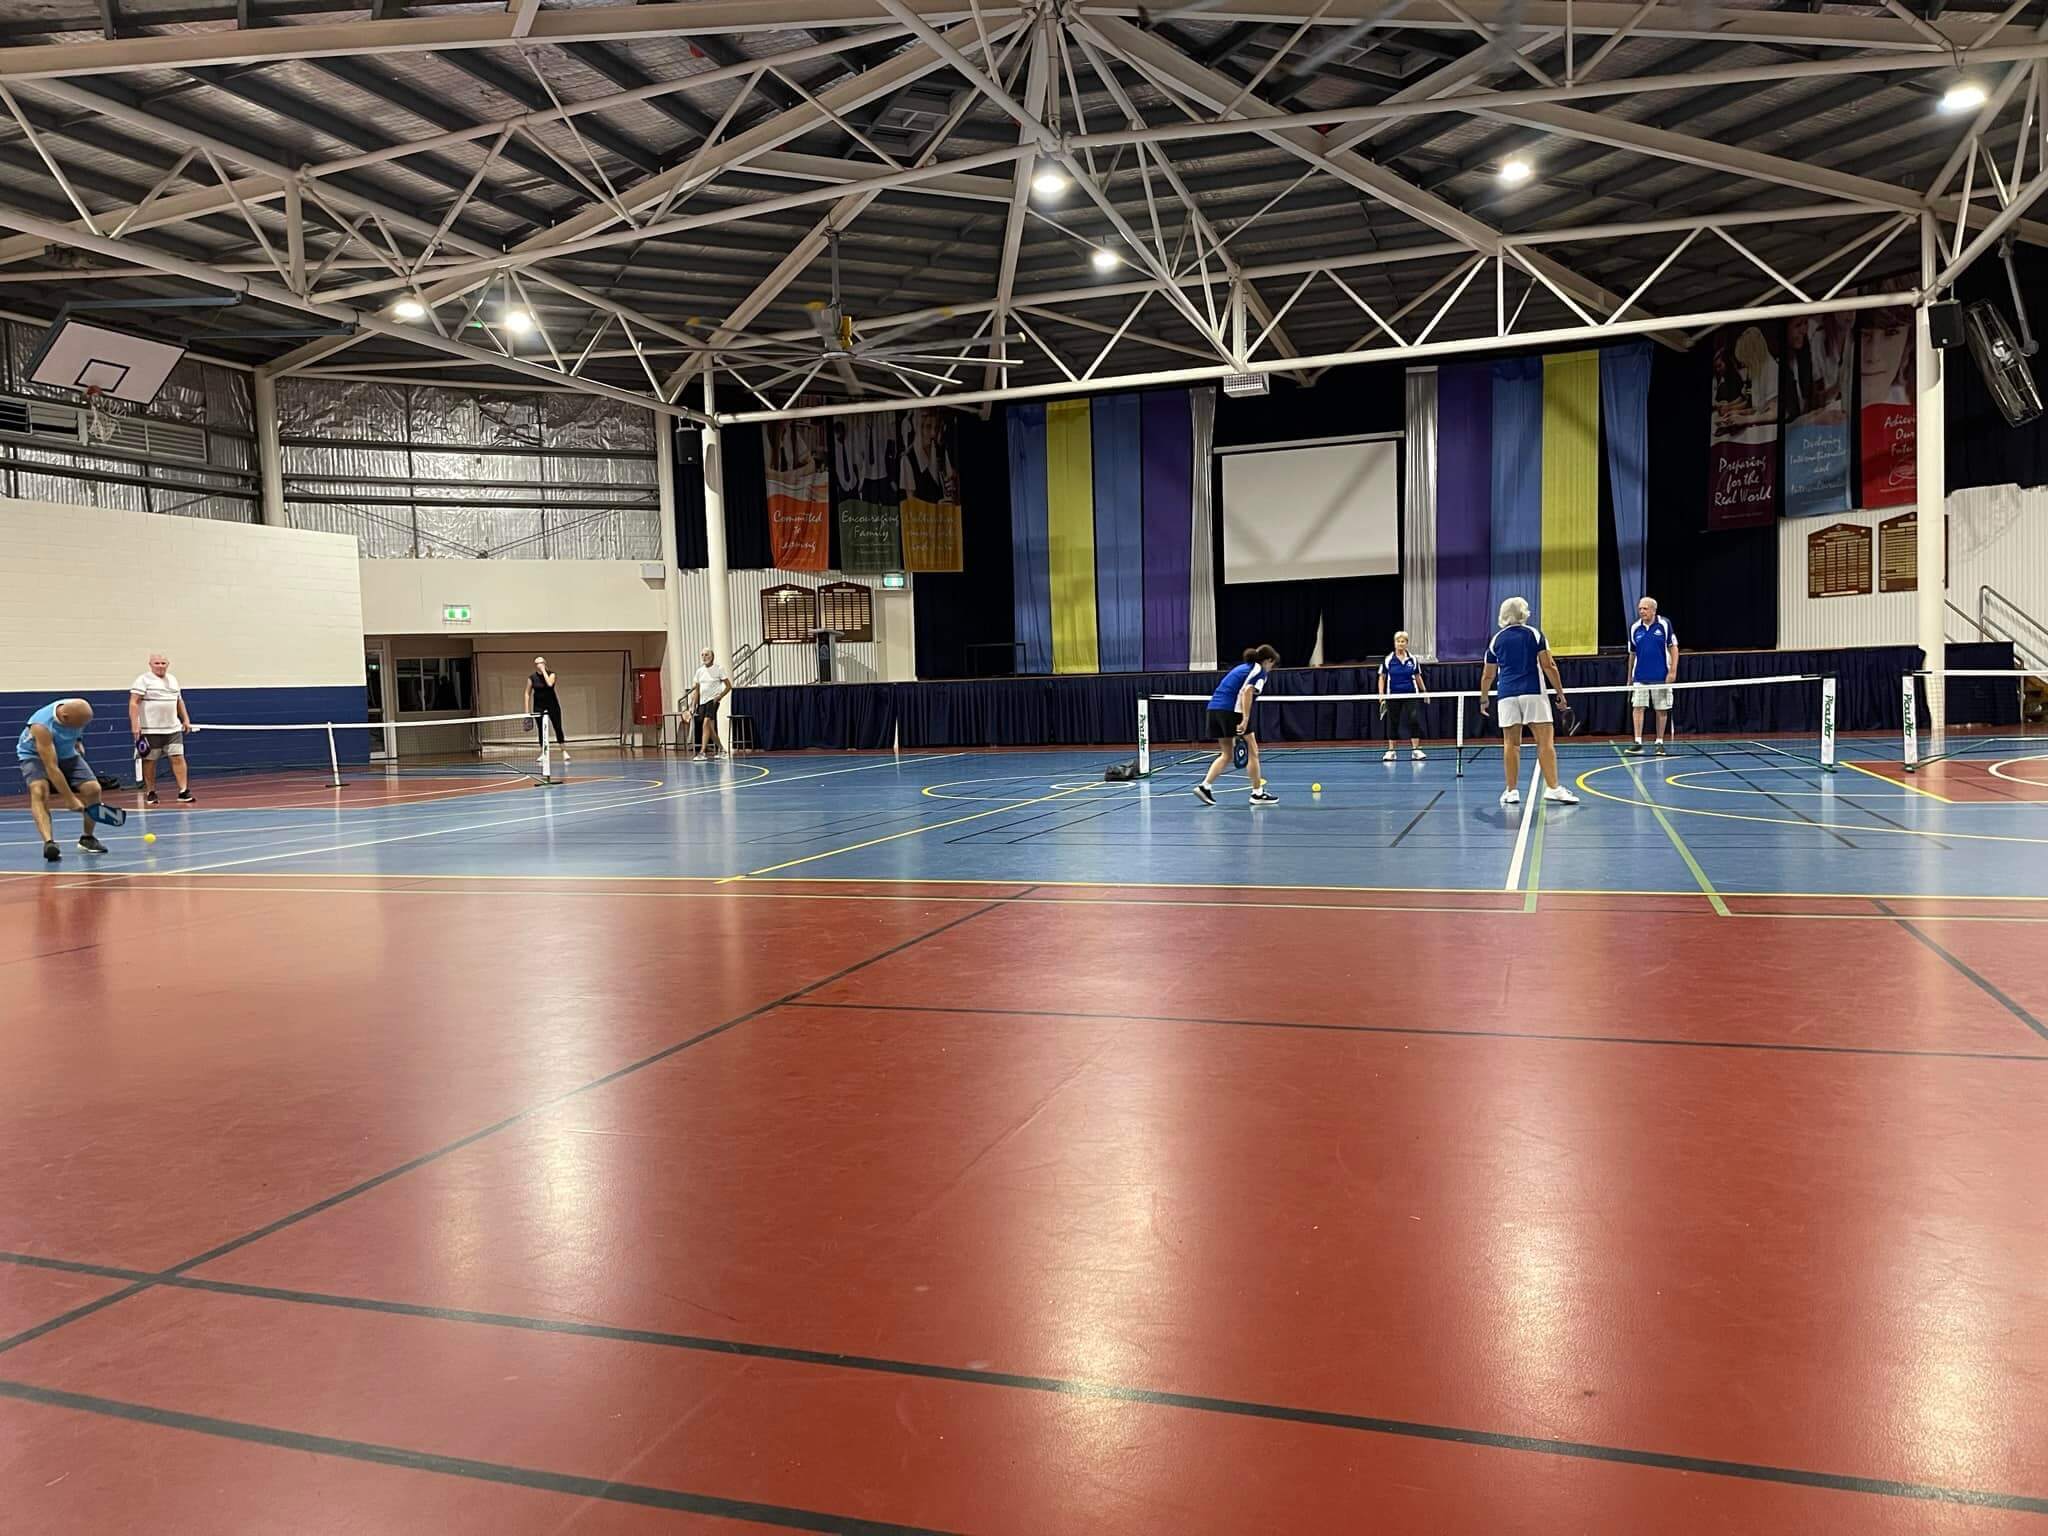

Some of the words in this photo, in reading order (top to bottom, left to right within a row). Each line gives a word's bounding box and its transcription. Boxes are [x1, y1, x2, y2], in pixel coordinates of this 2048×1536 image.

[1719, 455, 1767, 474] Preparing
[1727, 473, 1742, 494] for
[1743, 470, 1760, 486] the
[1715, 489, 1738, 506] Real
[1740, 485, 1772, 503] World
[773, 510, 823, 523] Committed
[841, 510, 899, 530] Encouraging
[854, 525, 889, 542] Family
